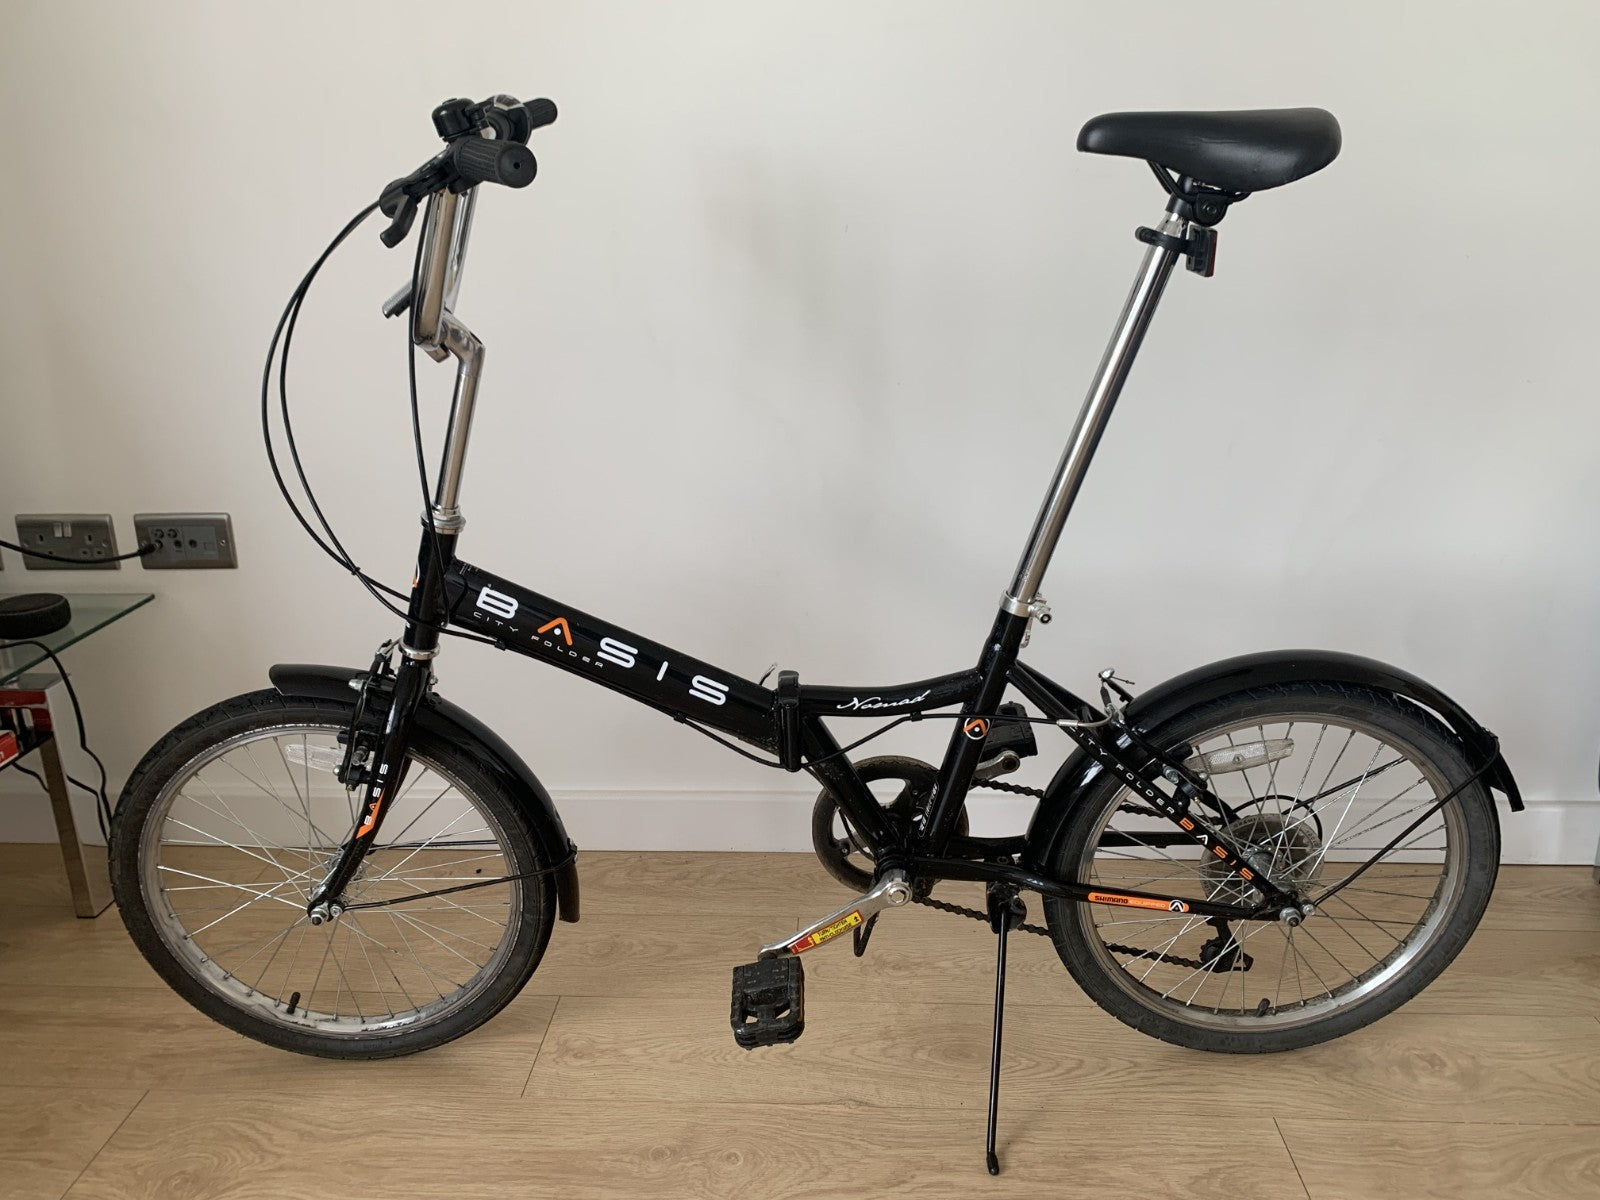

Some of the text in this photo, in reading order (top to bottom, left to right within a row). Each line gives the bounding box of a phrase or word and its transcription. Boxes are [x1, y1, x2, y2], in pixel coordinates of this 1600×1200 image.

[473, 611, 603, 668] CITY FOLDER
[476, 587, 730, 706] BASIS
[836, 689, 932, 711] Nomad
[364, 763, 389, 825] BASIS
[1115, 763, 1174, 814] FOLDER
[1179, 817, 1255, 881] BASIS
[1095, 895, 1128, 904] SHIMANO
